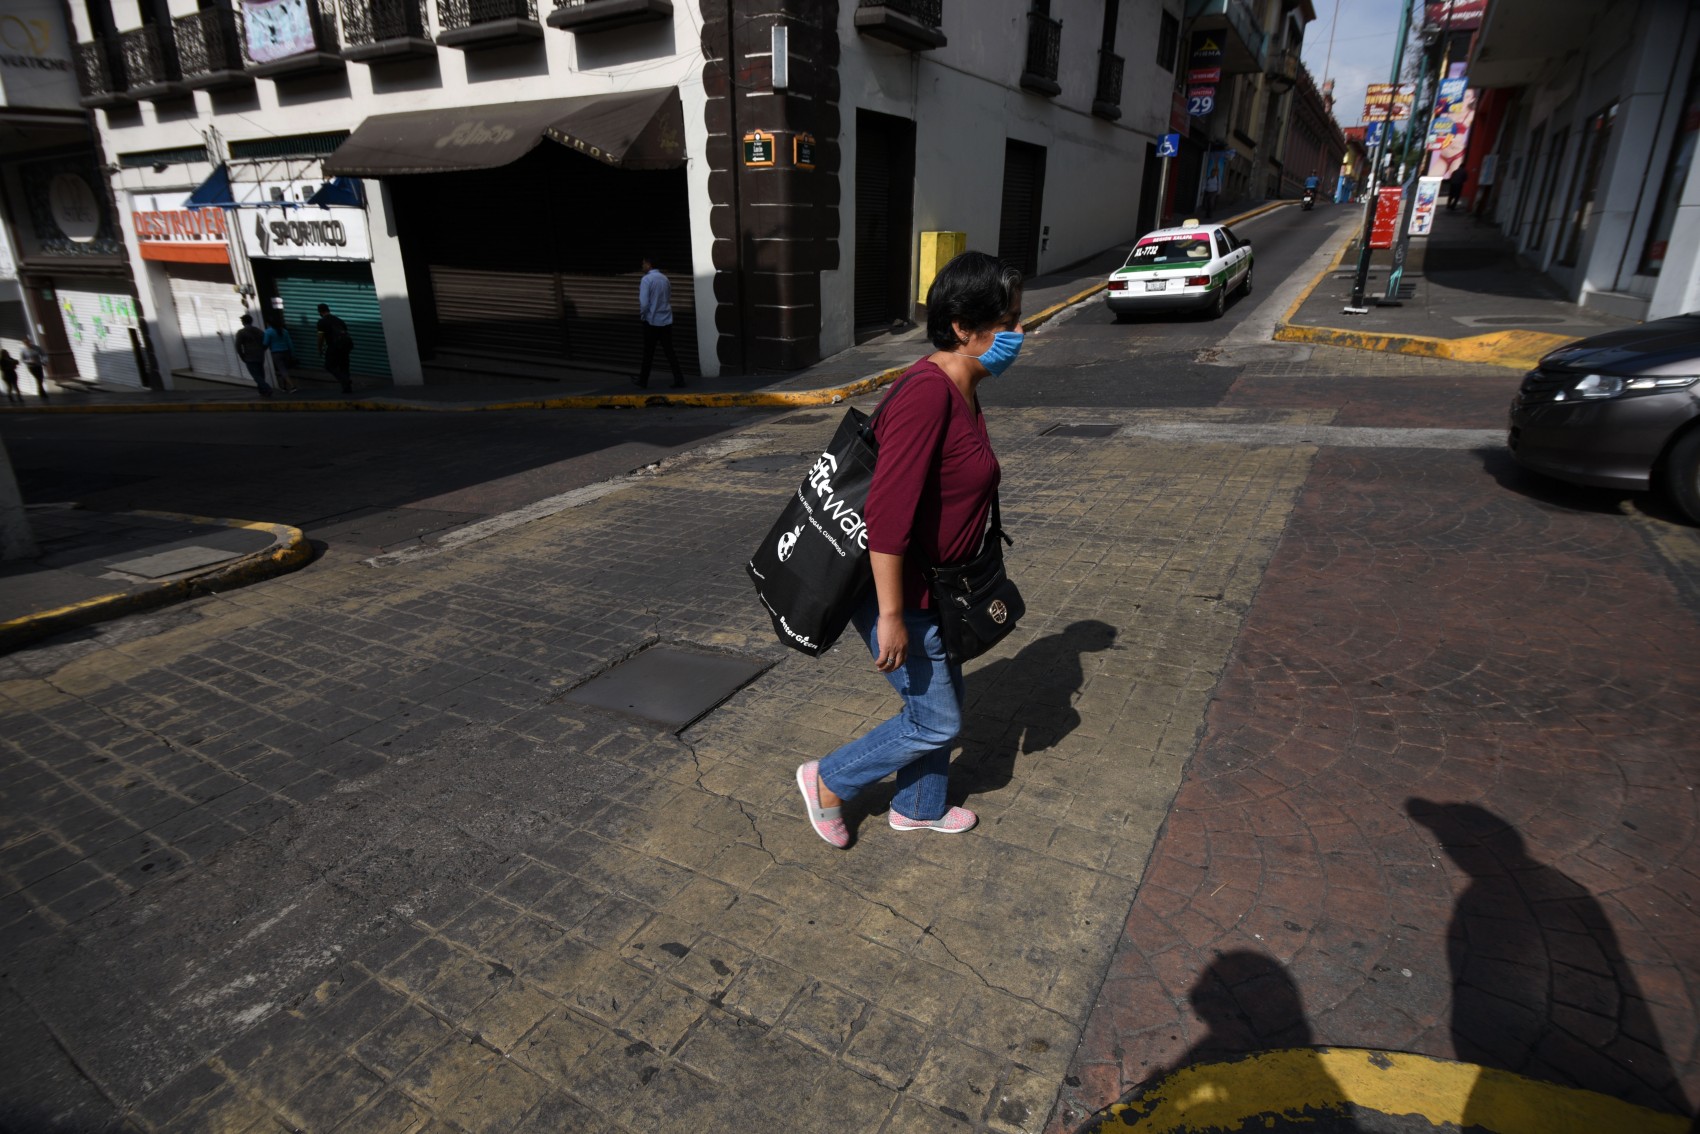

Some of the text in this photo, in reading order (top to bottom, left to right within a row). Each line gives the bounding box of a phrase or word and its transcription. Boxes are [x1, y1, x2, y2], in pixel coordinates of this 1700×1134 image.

[1190, 96, 1212, 113] 29
[1365, 94, 1413, 105] UNIVERIDAD
[132, 206, 228, 237] DESTROYER
[1133, 245, 1159, 258] XL-7732
